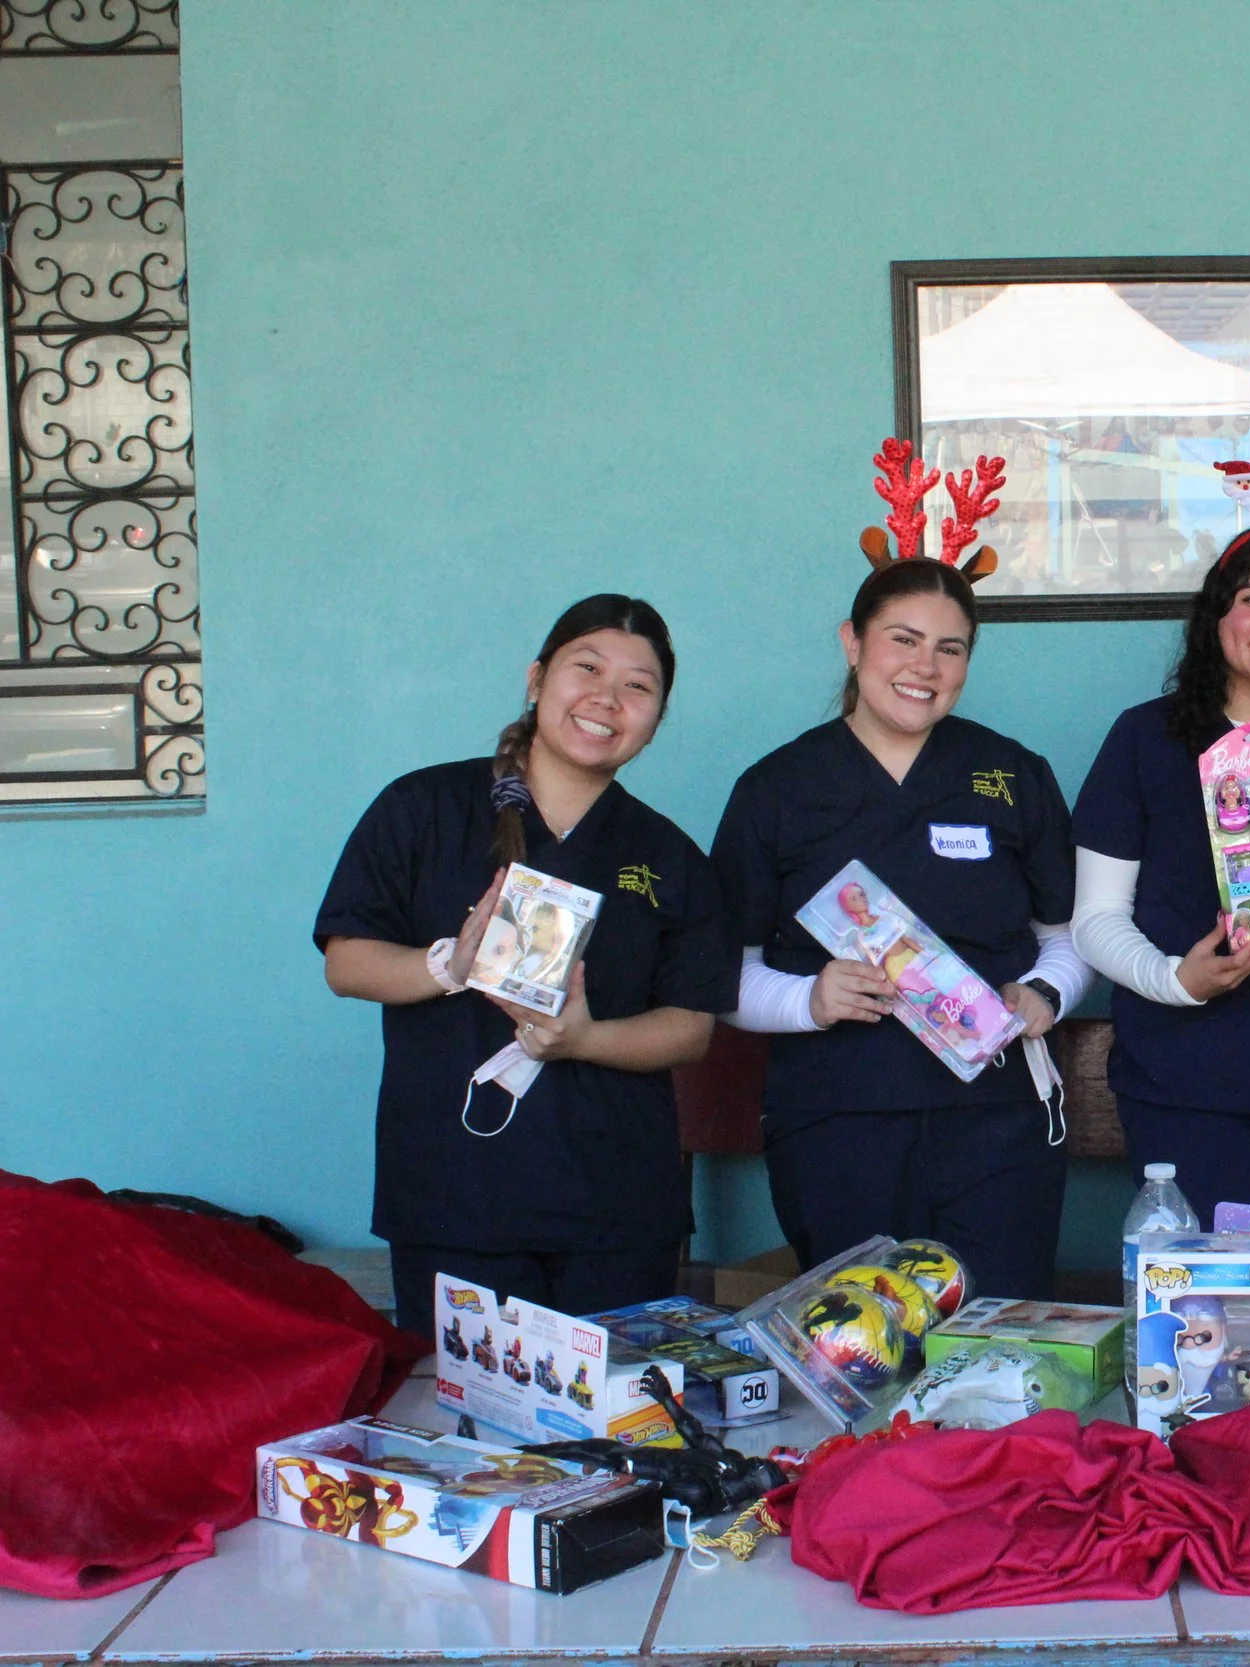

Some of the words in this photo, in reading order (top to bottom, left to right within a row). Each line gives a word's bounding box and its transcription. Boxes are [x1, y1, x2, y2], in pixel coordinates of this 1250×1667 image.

[935, 836, 978, 850] Veronica
[940, 985, 982, 1024] Barbie
[1145, 1267, 1192, 1291] POP!
[572, 1328, 602, 1358] MARVEL
[742, 1382, 768, 1404] DC
